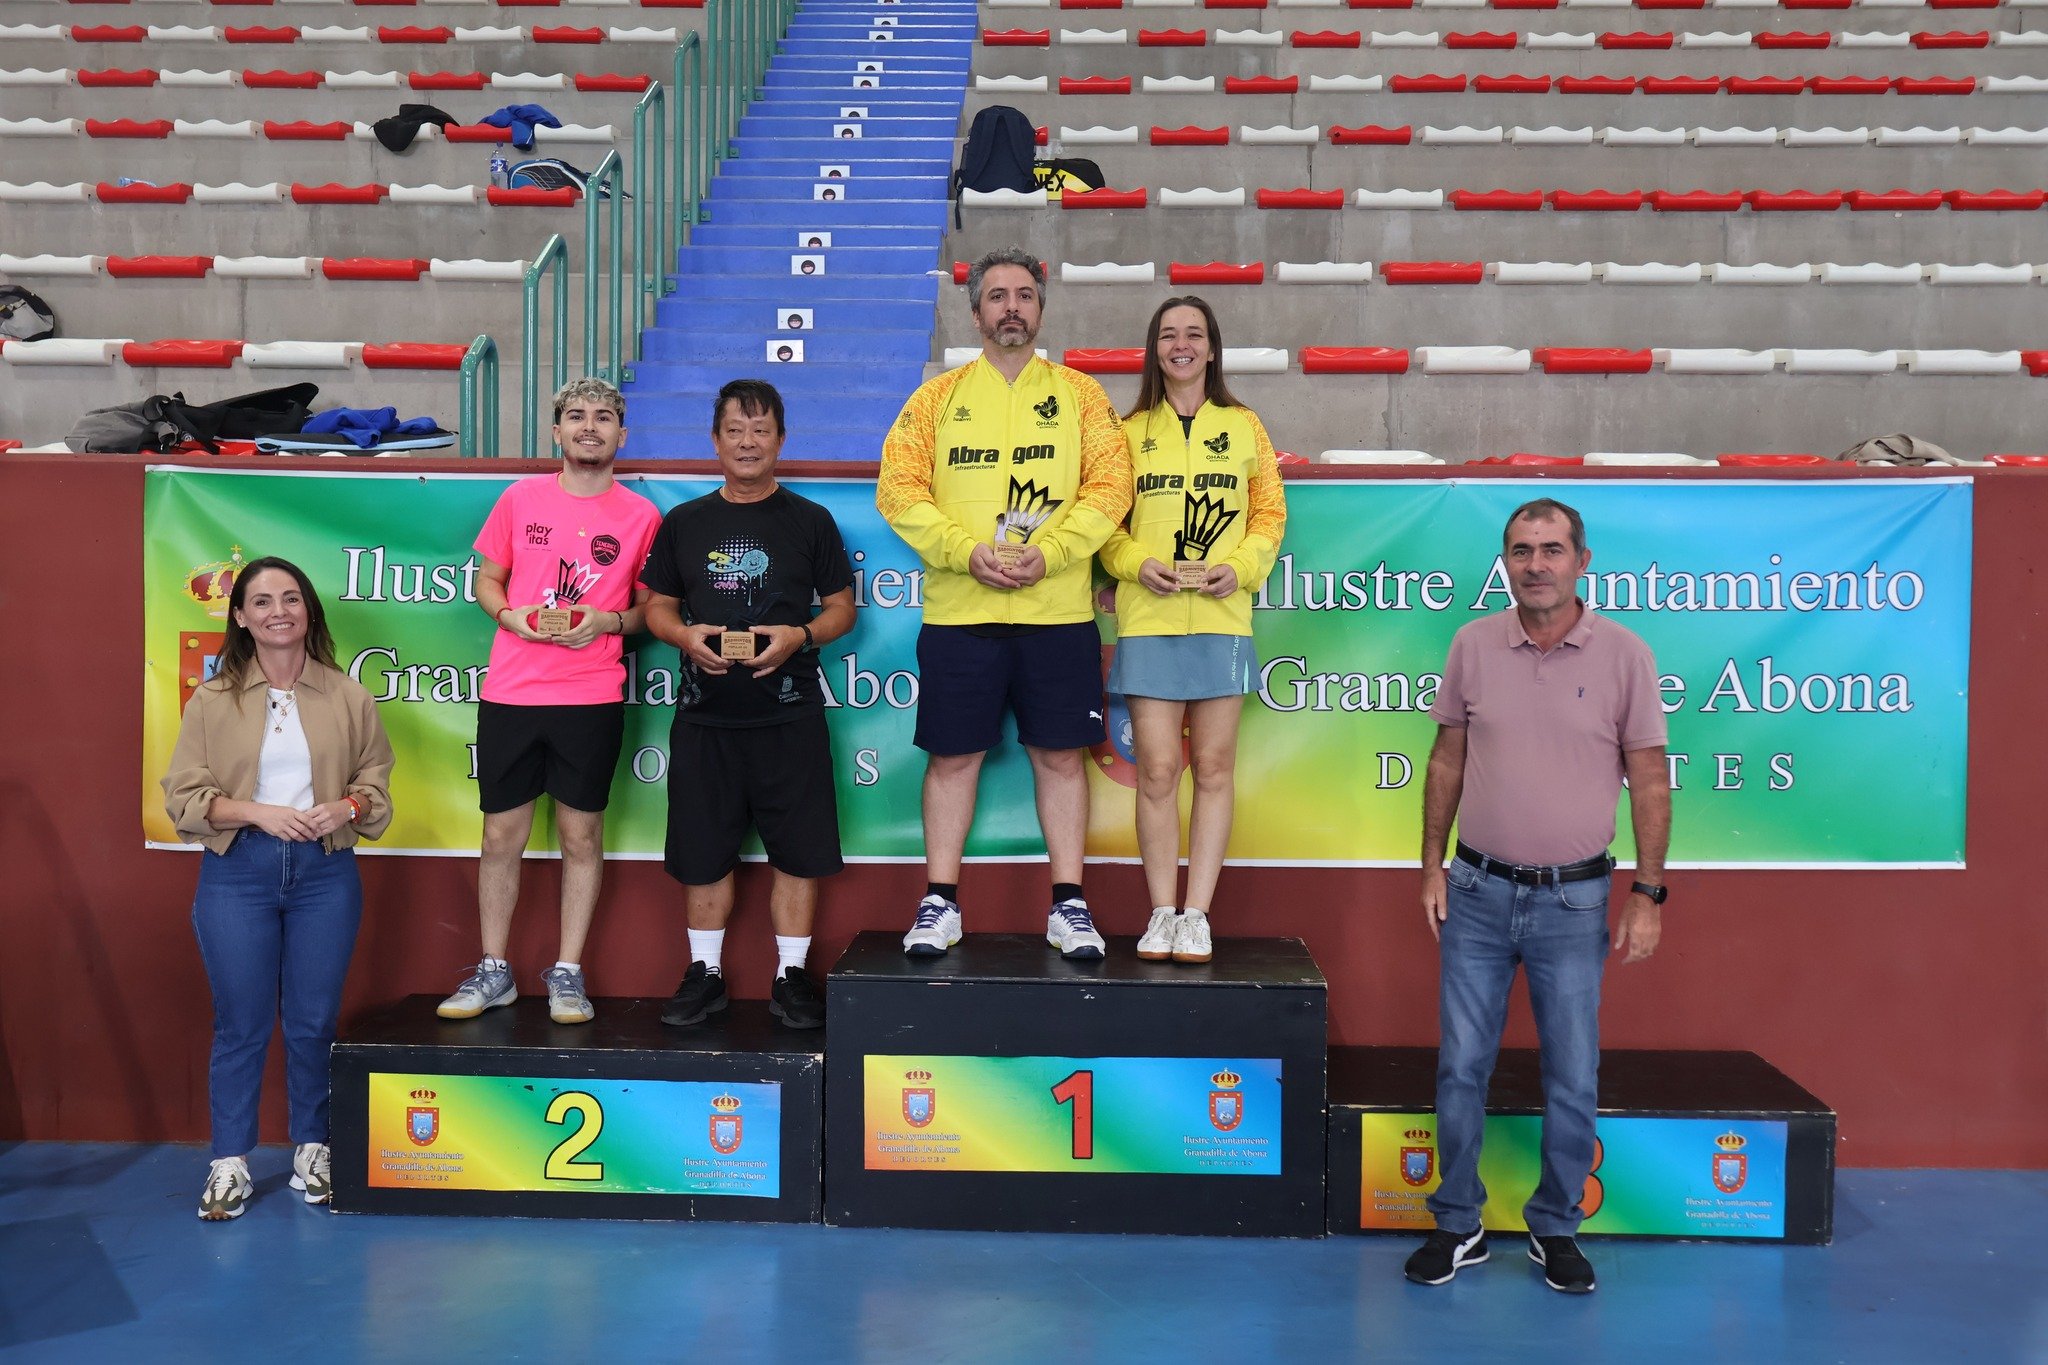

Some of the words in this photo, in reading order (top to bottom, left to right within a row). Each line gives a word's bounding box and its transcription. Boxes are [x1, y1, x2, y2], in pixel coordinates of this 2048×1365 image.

[948, 446, 1000, 466] Abra
[1012, 444, 1055, 465] gon
[1137, 473, 1185, 495] Abra
[1193, 473, 1238, 491] gon
[525, 522, 553, 537] play
[528, 534, 549, 545] itas
[339, 546, 481, 603] Ilust
[1469, 554, 1925, 612] Auntamiento
[1699, 656, 1915, 713] Abona
[1051, 1070, 1093, 1159] 1
[545, 1090, 604, 1181] 2
[1183, 1135, 1210, 1144] Ilustre
[1212, 1136, 1269, 1146] Ayuntamiento
[381, 1148, 407, 1158] Ilustre
[410, 1150, 465, 1161] Ayuntamiento
[1184, 1148, 1227, 1157] Granadilla
[1229, 1149, 1239, 1157] de
[1241, 1149, 1268, 1158] Abona
[381, 1161, 423, 1171] Granadilla
[425, 1163, 435, 1171] de
[436, 1163, 463, 1173] Abona
[684, 1157, 709, 1167] Ilustre
[713, 1158, 768, 1169] Ayuntamiento
[684, 1170, 727, 1179] Granadilla
[728, 1171, 739, 1179] de
[740, 1172, 767, 1181] Abona
